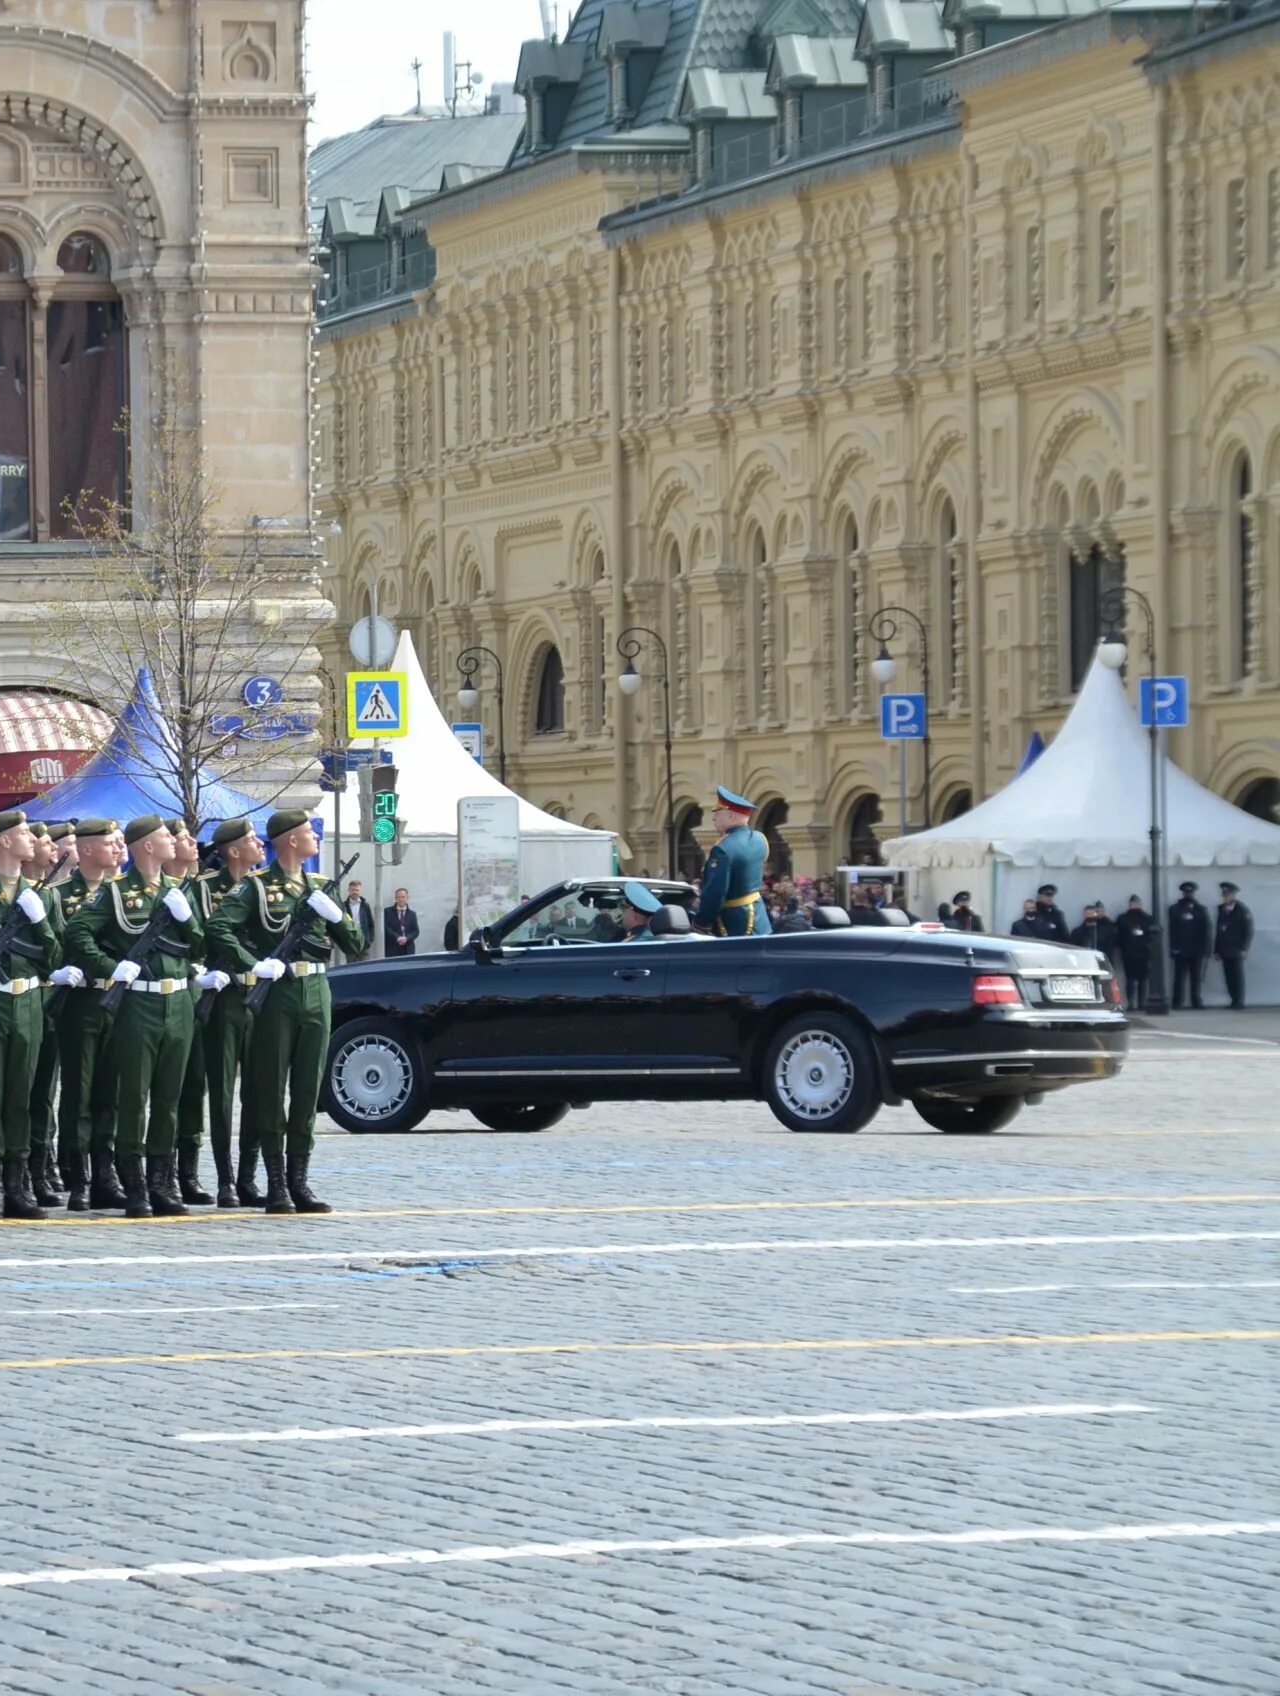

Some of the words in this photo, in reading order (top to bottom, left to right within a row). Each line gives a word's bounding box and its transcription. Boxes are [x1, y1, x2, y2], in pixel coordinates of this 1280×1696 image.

[256, 682, 271, 704] 3
[891, 699, 915, 733] P
[375, 793, 395, 815] 20
